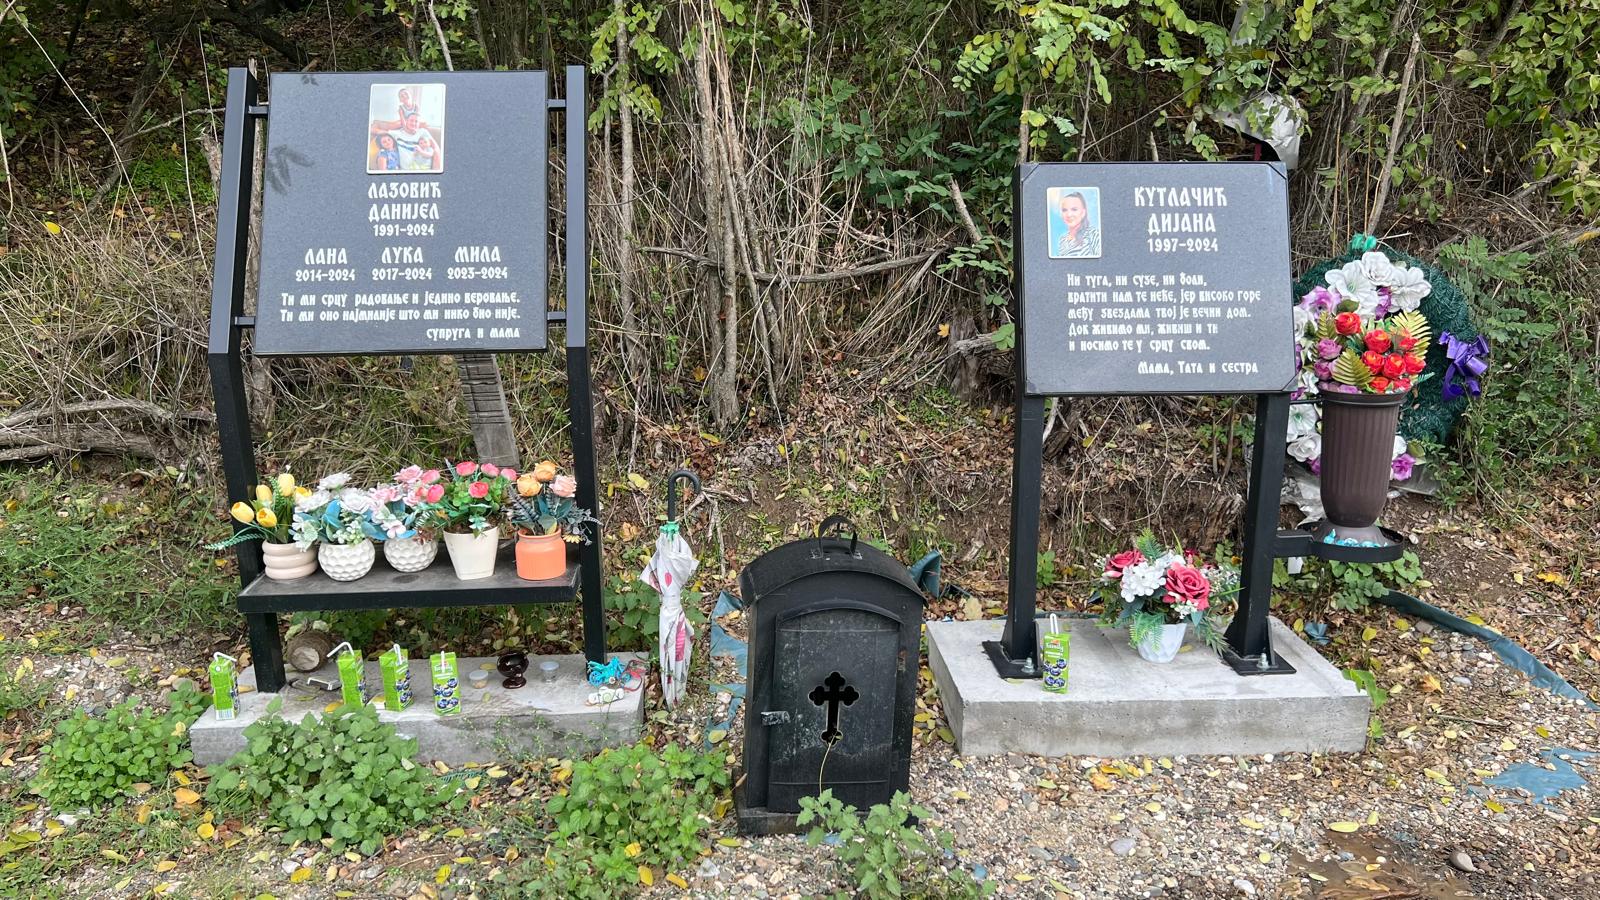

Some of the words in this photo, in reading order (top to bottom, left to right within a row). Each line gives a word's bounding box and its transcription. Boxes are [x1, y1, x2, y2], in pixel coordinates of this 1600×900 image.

[368, 182, 442, 199] ЛАЗОВИЋ
[1134, 187, 1228, 207] КУТЛАЧИЋ
[368, 203, 440, 222] ДАНИЈЕЛ
[373, 224, 435, 237] 1991-2024
[1148, 213, 1216, 235] ДИЈАНА
[454, 245, 501, 263] МИЛА
[1147, 238, 1219, 253] 1997-2024
[304, 247, 348, 265] ЛАНА
[381, 247, 424, 264] ЛУКА
[295, 269, 356, 282] 2014-2024
[372, 268, 432, 281] 2017-2024
[447, 267, 508, 280] 2023-2024
